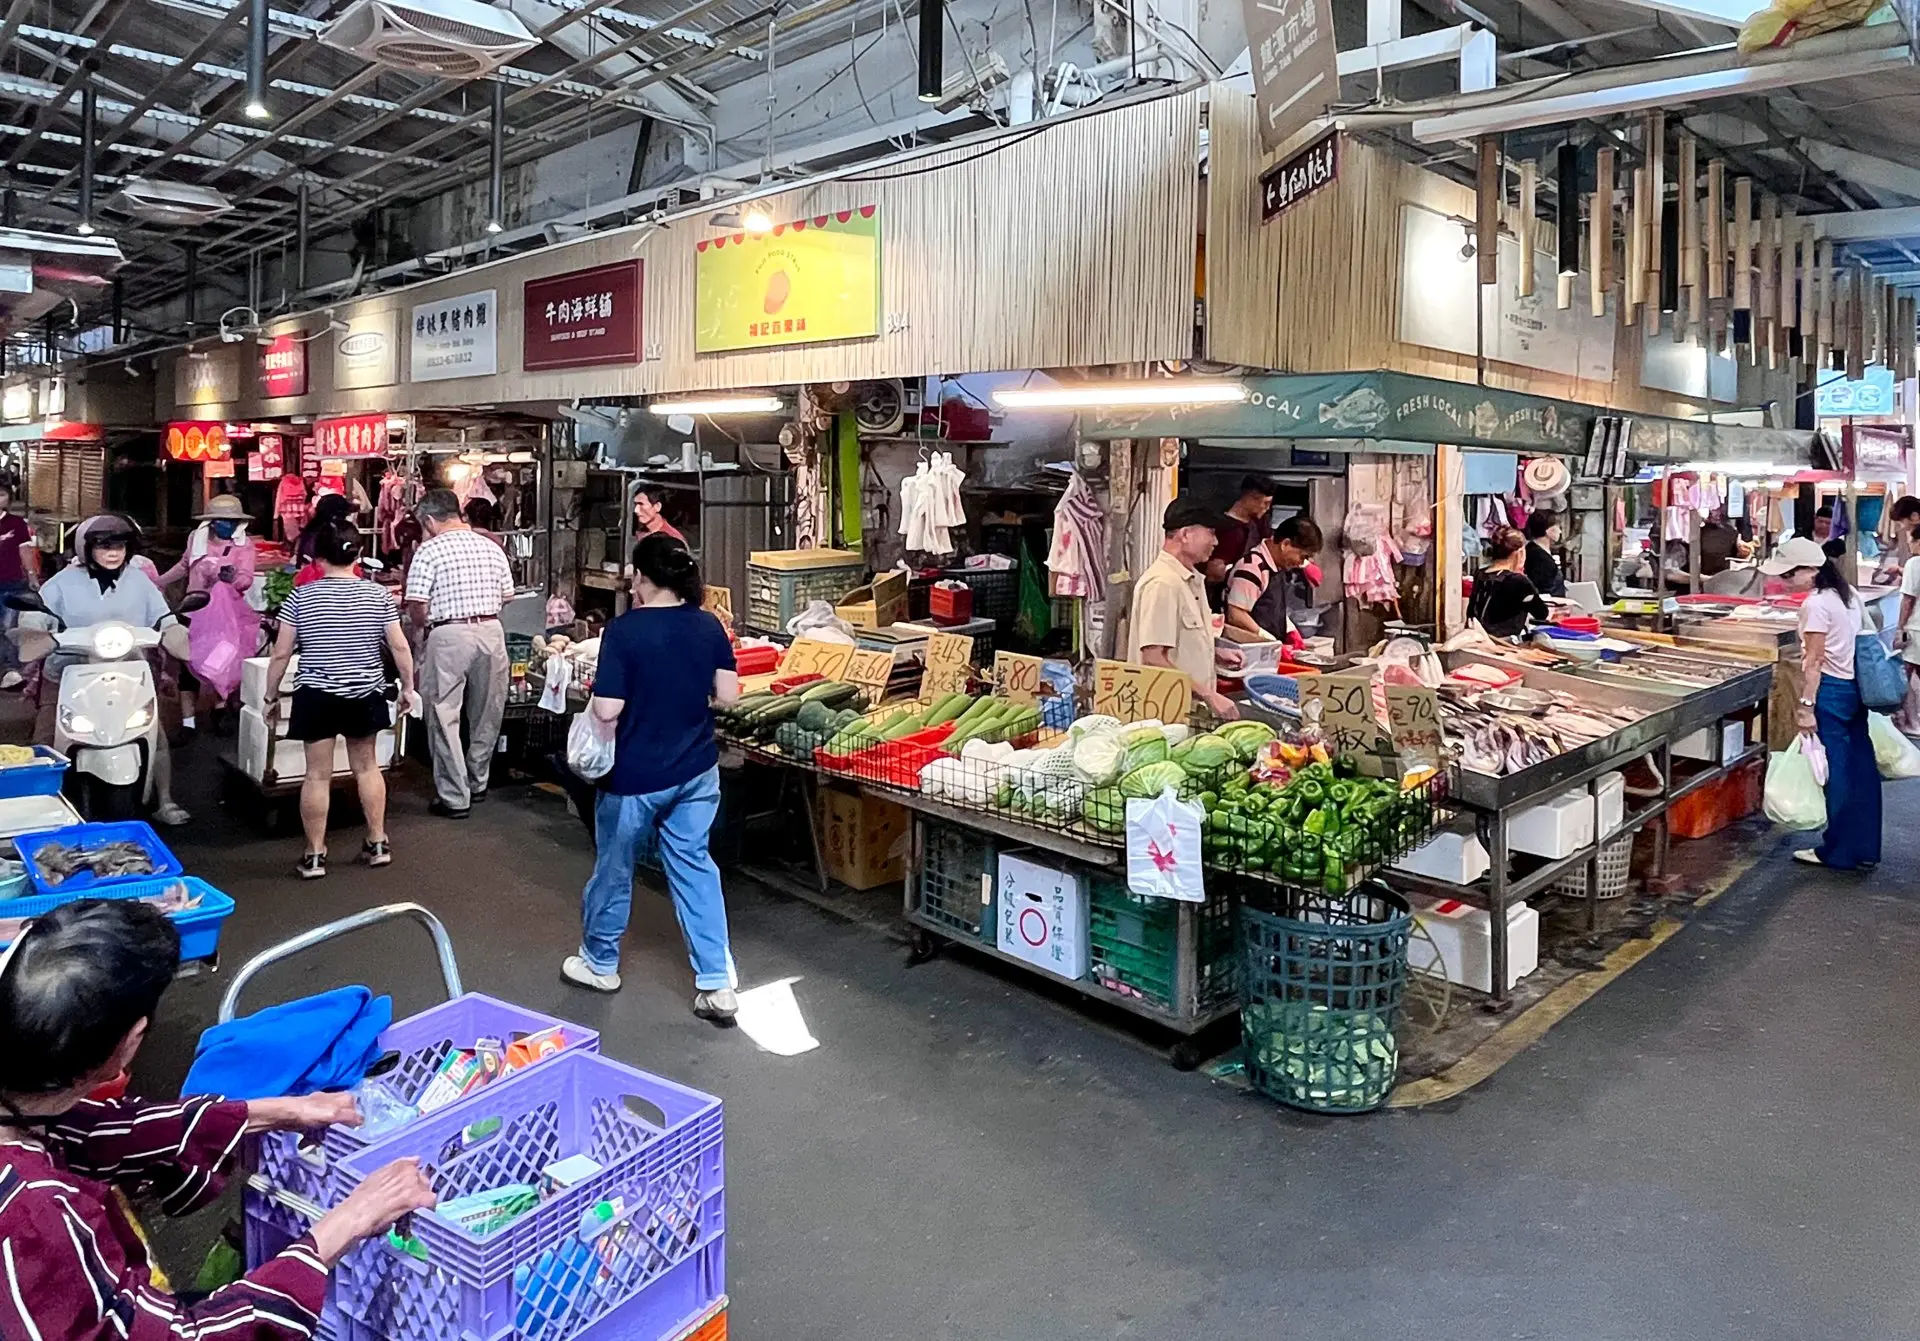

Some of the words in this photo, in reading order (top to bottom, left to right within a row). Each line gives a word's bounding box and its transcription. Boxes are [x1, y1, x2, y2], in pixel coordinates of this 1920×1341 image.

[1396, 394, 1429, 422] FRESH
[1432, 396, 1462, 428] LOCAL
[1504, 407, 1531, 432] FRESH
[942, 638, 969, 665] 45
[1010, 660, 1038, 691] 80
[1143, 670, 1185, 725] 60
